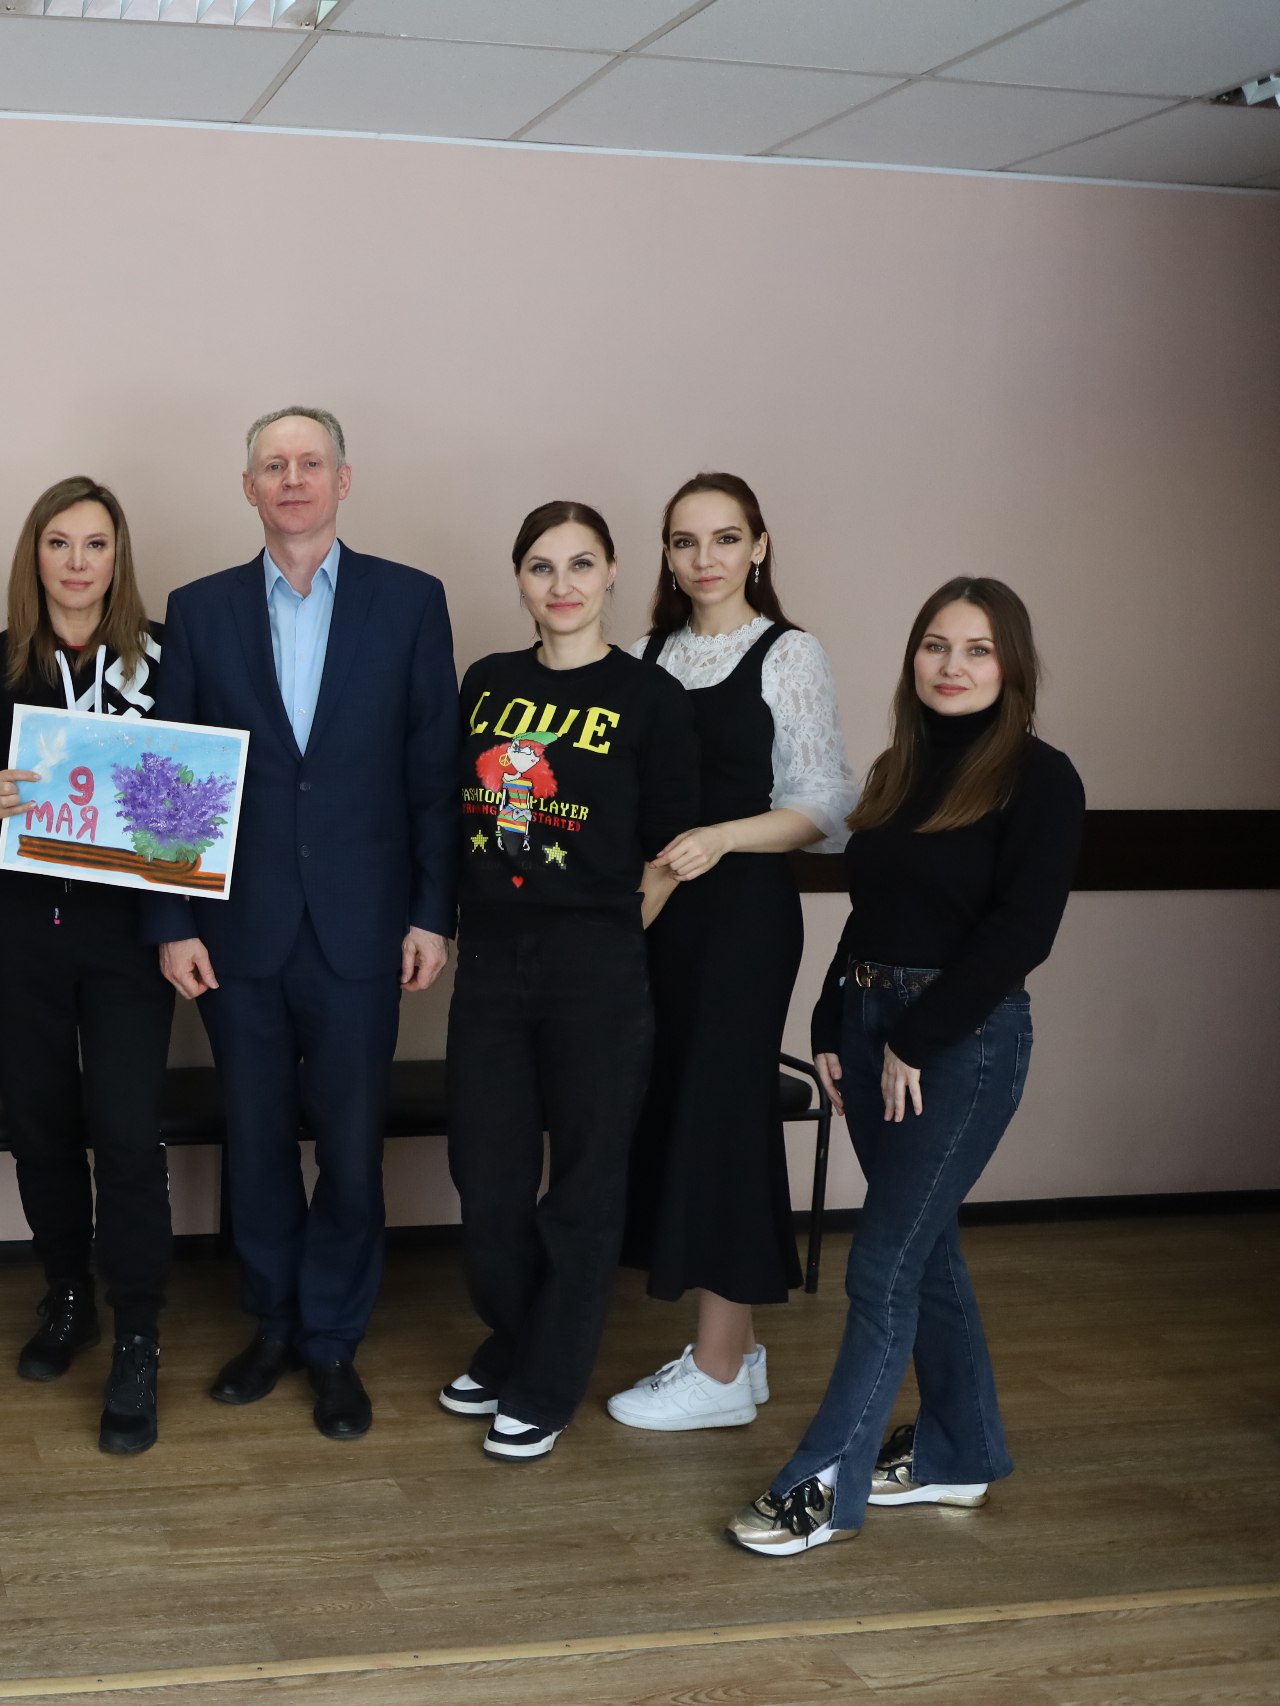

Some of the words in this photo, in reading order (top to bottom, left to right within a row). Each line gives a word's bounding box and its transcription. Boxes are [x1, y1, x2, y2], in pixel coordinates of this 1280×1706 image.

[469, 691, 621, 755] LOVE
[68, 765, 95, 806] 9
[25, 800, 99, 843] МАЯ
[529, 795, 590, 821] PLAYER
